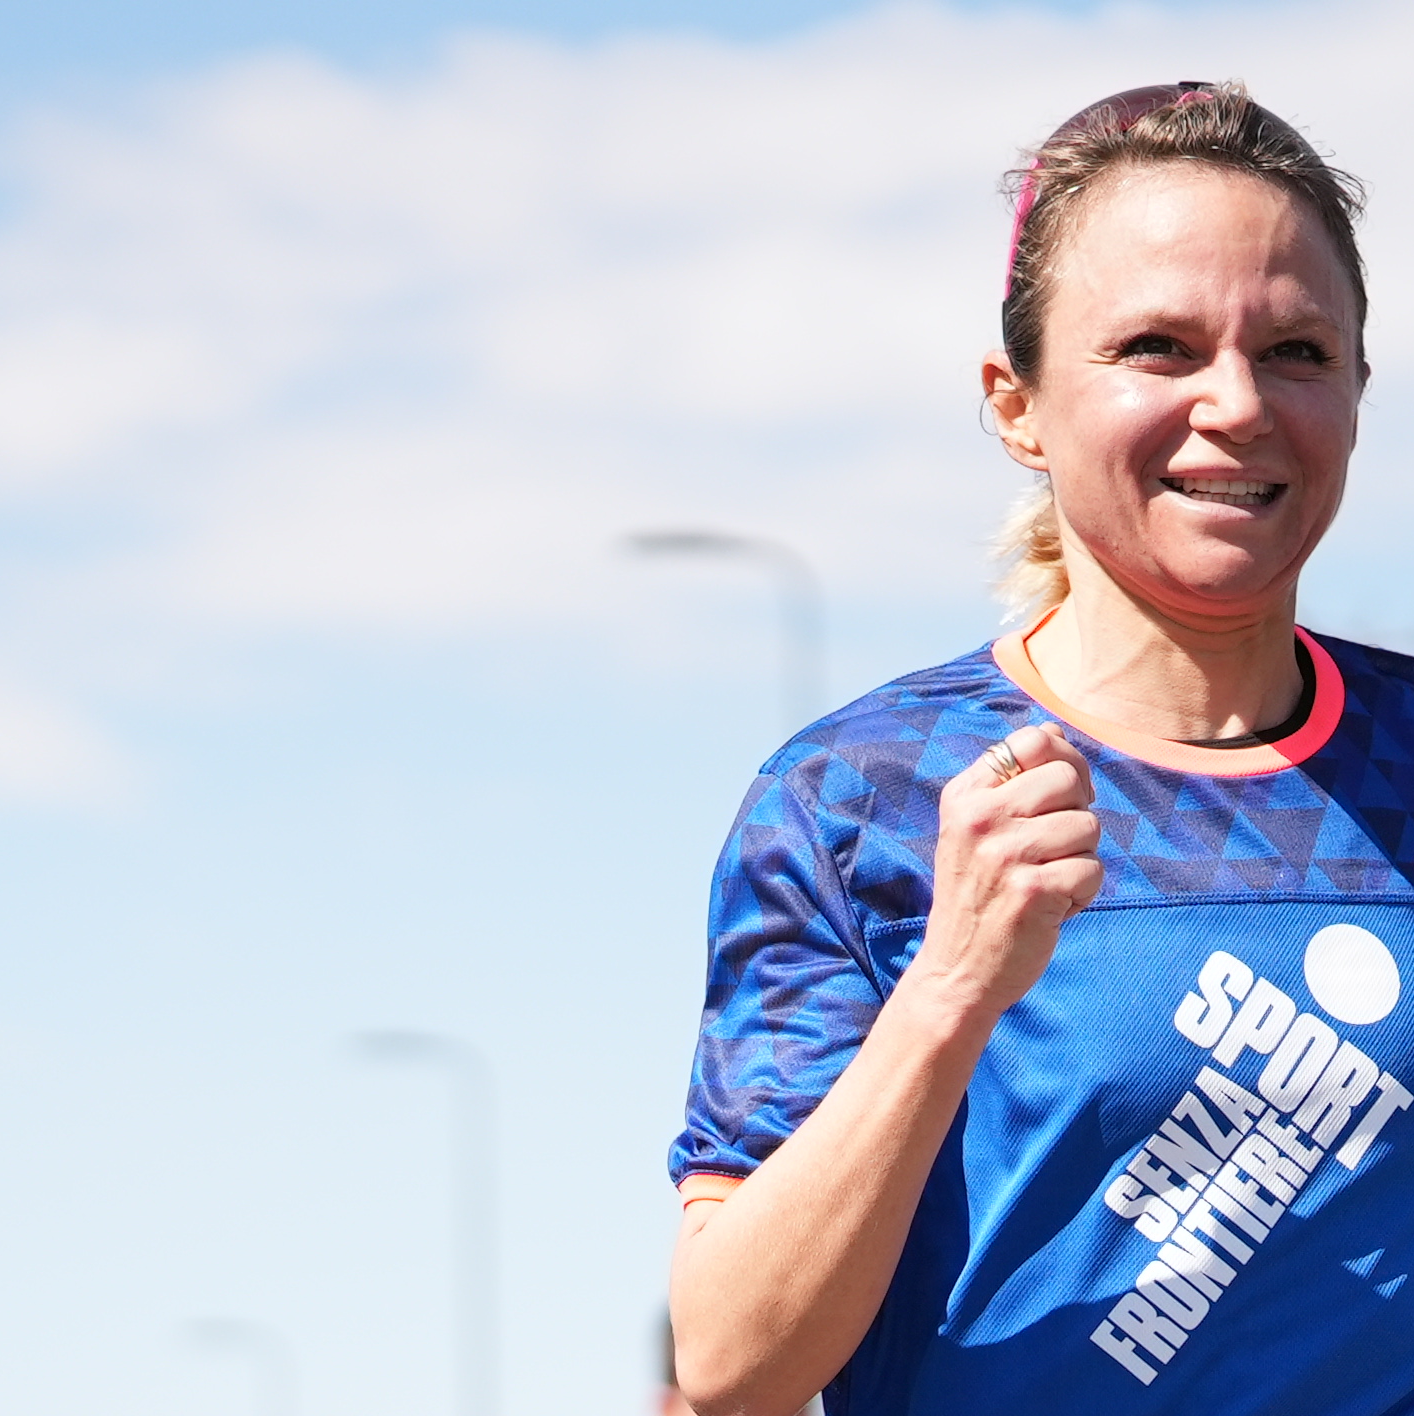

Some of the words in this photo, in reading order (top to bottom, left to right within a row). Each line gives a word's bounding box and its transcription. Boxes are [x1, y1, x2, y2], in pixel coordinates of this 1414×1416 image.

[1103, 1064, 1268, 1243] SENZA
[1173, 950, 1414, 1171] SPORT
[1089, 1106, 1325, 1386] FRONTIERE
